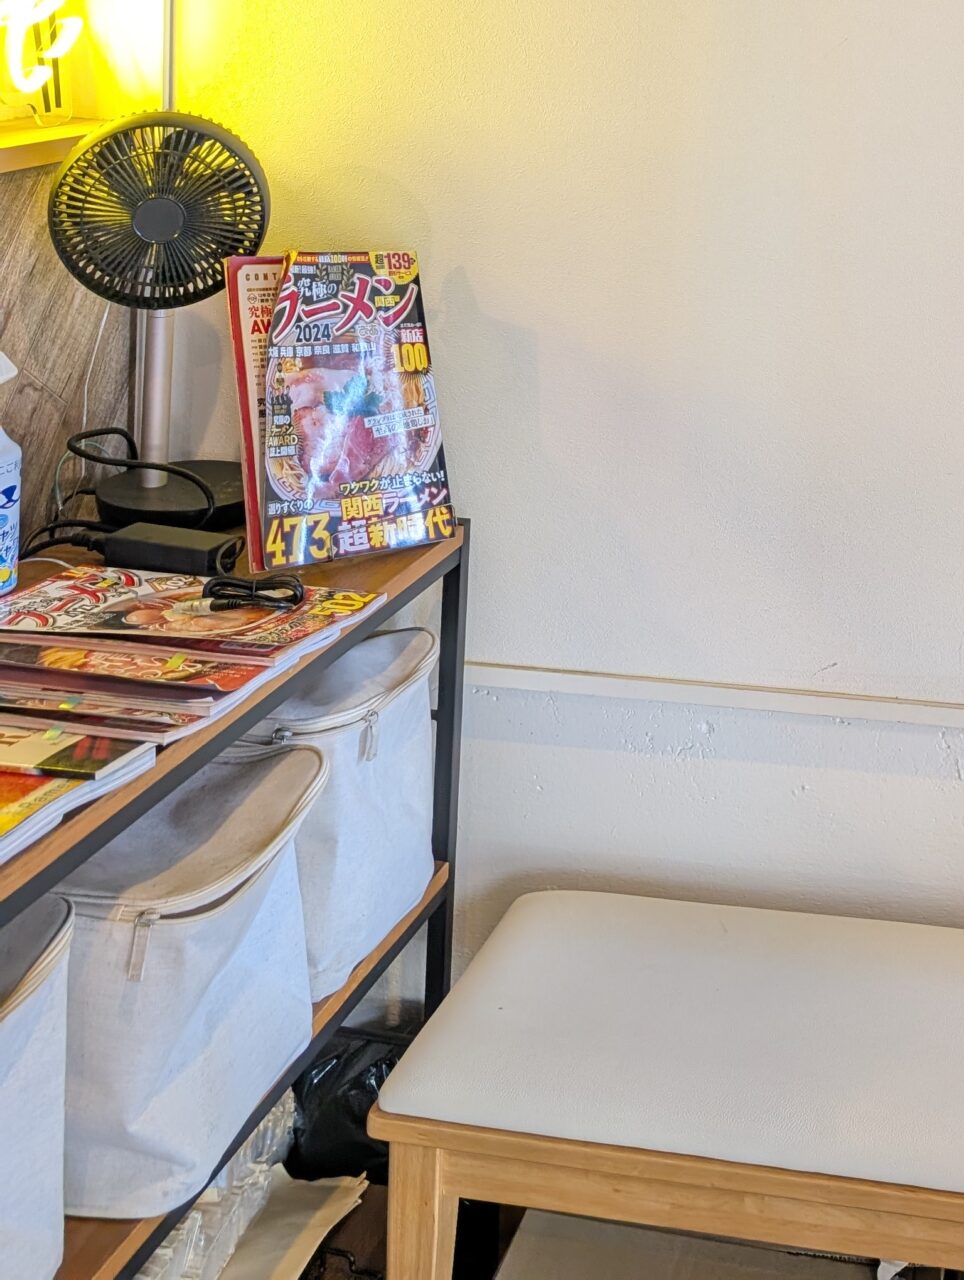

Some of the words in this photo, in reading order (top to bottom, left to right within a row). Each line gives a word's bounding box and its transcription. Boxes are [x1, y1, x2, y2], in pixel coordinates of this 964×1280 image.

[384, 252, 411, 270] 139
[297, 277, 337, 301] 究極の
[272, 272, 418, 344] ラーメン
[295, 323, 332, 343] 2024
[391, 343, 428, 373] 100
[268, 433, 299, 448] AWARD
[339, 470, 446, 496] ワクワクが止まらない!
[340, 486, 448, 521] 関西ラーメン
[265, 511, 331, 567] 473
[337, 506, 453, 555] 超新時代
[309, 592, 378, 617] 502
